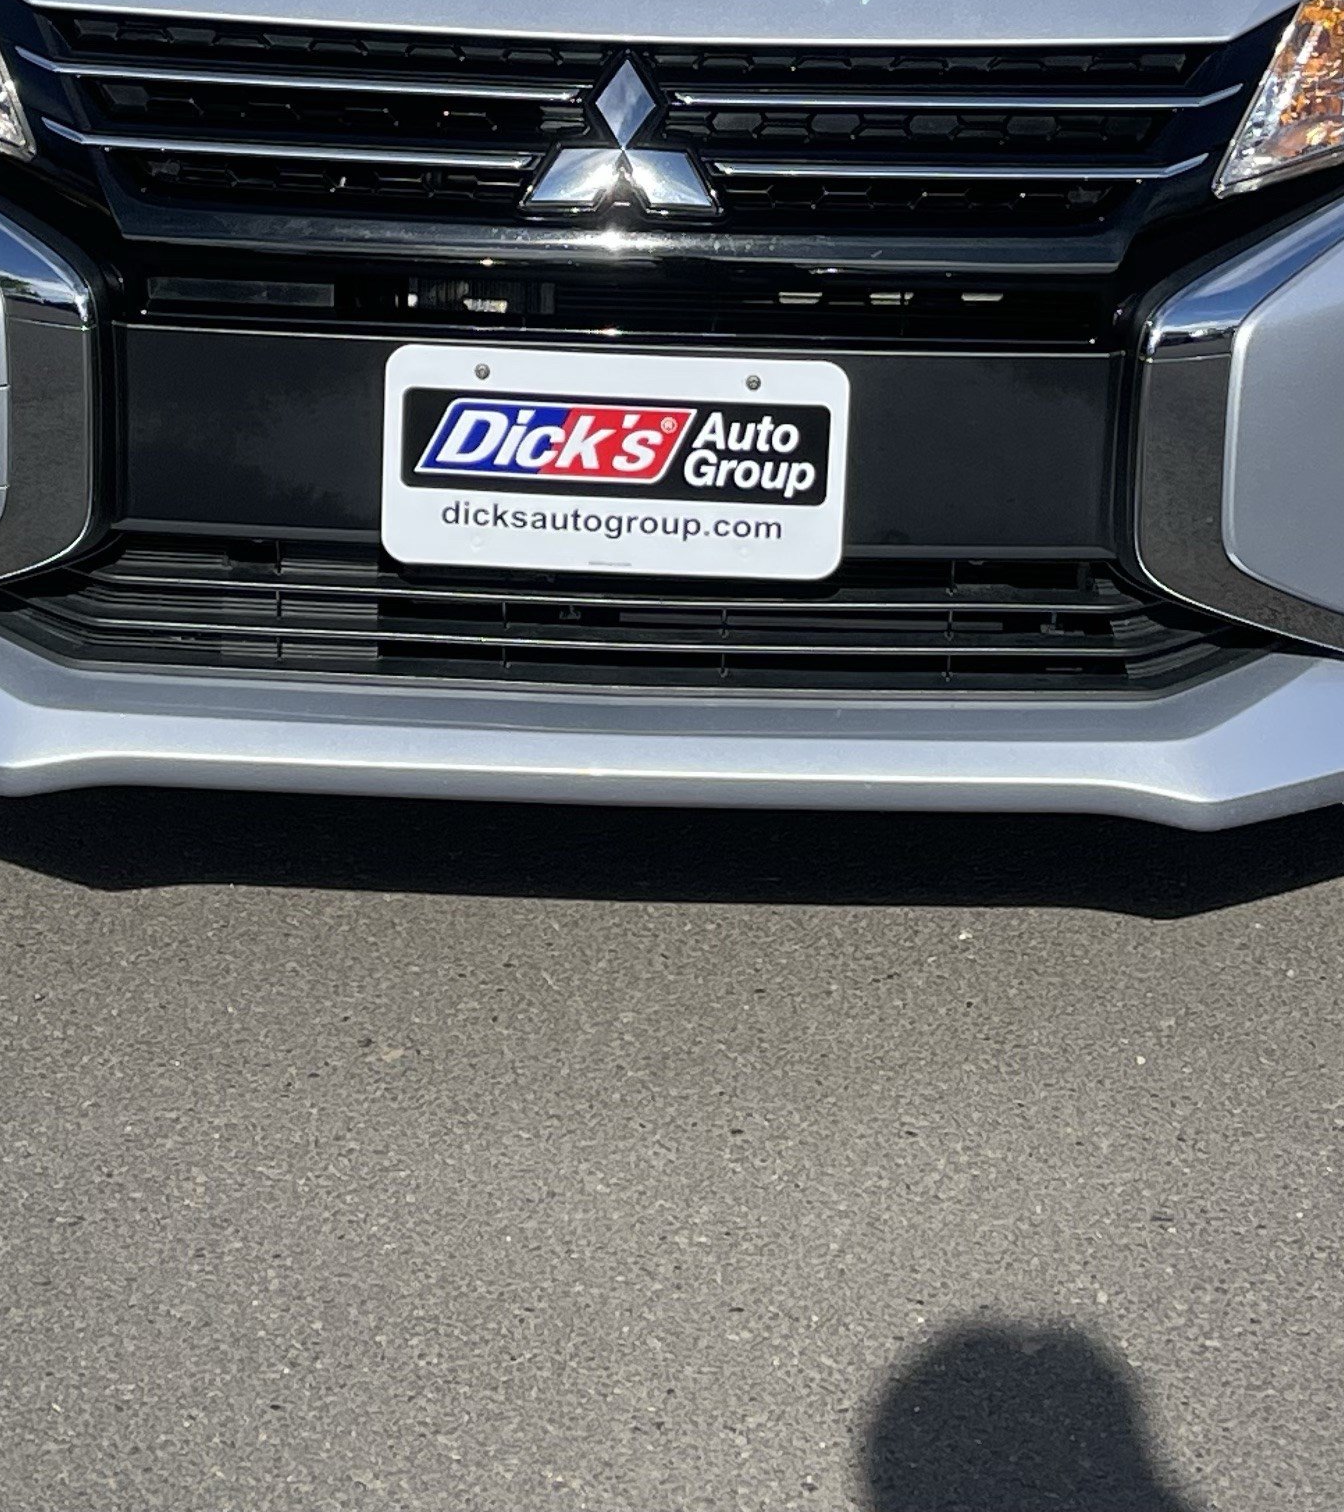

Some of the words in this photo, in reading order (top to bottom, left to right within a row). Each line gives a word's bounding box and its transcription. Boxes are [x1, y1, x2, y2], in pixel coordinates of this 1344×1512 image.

[436, 408, 663, 472] Dick's
[694, 412, 799, 452] Auto
[683, 451, 816, 497] Group
[442, 501, 782, 541] dicksautogroup.com
